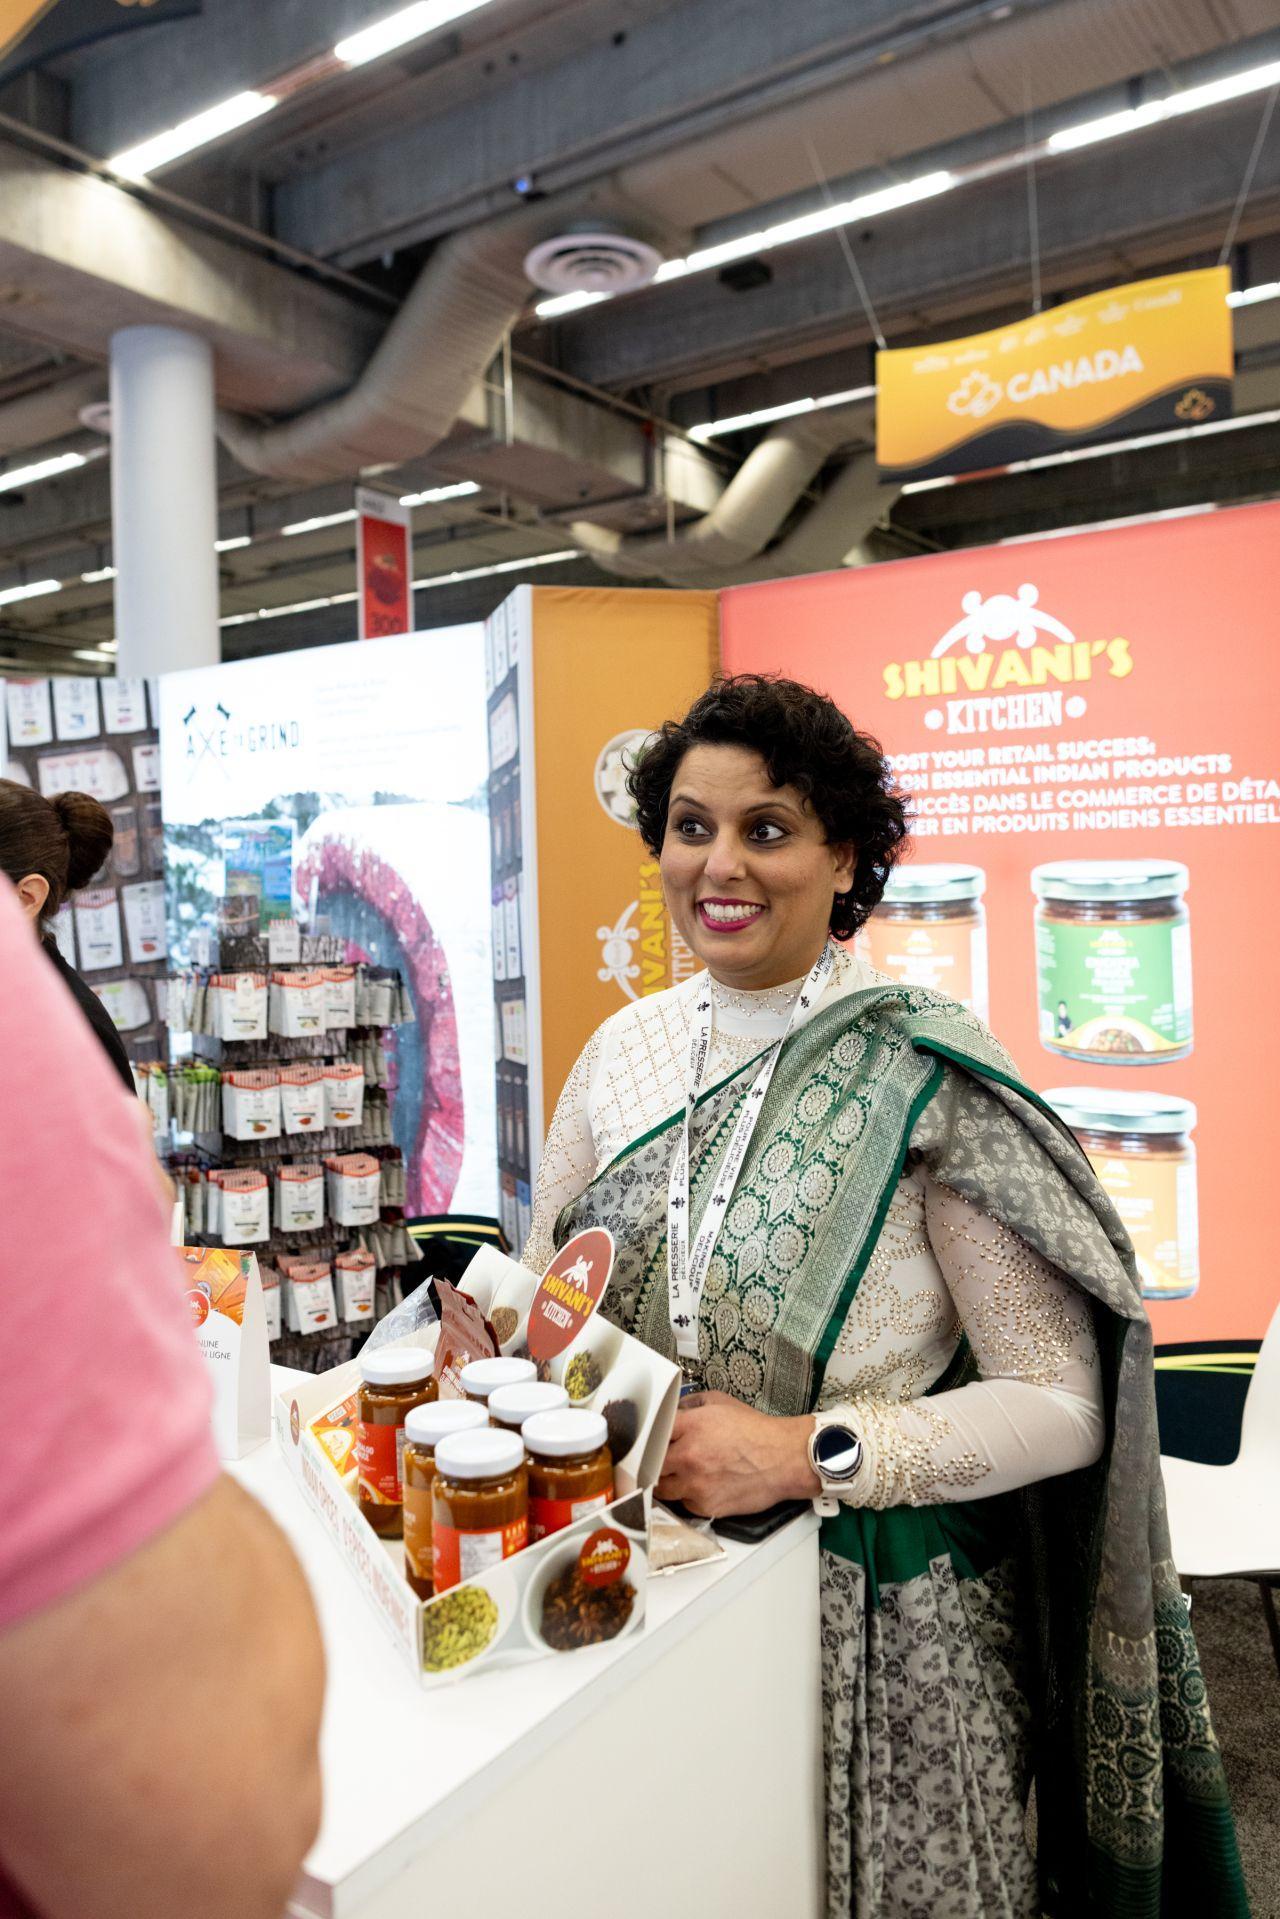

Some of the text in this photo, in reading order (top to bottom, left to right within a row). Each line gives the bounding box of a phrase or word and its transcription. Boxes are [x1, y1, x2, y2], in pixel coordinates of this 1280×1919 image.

[1006, 345, 1144, 402] CANADA
[883, 636, 1134, 700] SHIVANI'S
[946, 690, 1063, 735] KITCHEN
[899, 753, 1232, 791] ON ESSENTIAL INDIAN PRODUCTS
[931, 748, 984, 769] YOUR
[988, 742, 1054, 765] RETAIL
[1056, 736, 1156, 760] SUCCESS:
[904, 791, 970, 815] UCCÈS
[974, 792, 1028, 813] DANS
[1031, 790, 1054, 810] LE
[1056, 785, 1183, 809] COMMERCE
[1186, 782, 1218, 803] DE
[942, 817, 967, 835] EN
[972, 812, 1069, 834] PRODUITS
[1072, 807, 1160, 830] INDIENS
[1164, 803, 1280, 827] ESSENTIEL
[639, 862, 668, 997] IVANI'S
[693, 1026, 710, 1089] LA PRESSERIE
[670, 1222, 680, 1299] LA PRESSERIE
[698, 1231, 714, 1269] MAKING
[542, 1274, 594, 1317] SHIVANI'S
[198, 1339, 219, 1349] NLINE
[209, 1350, 232, 1361] LIGNE
